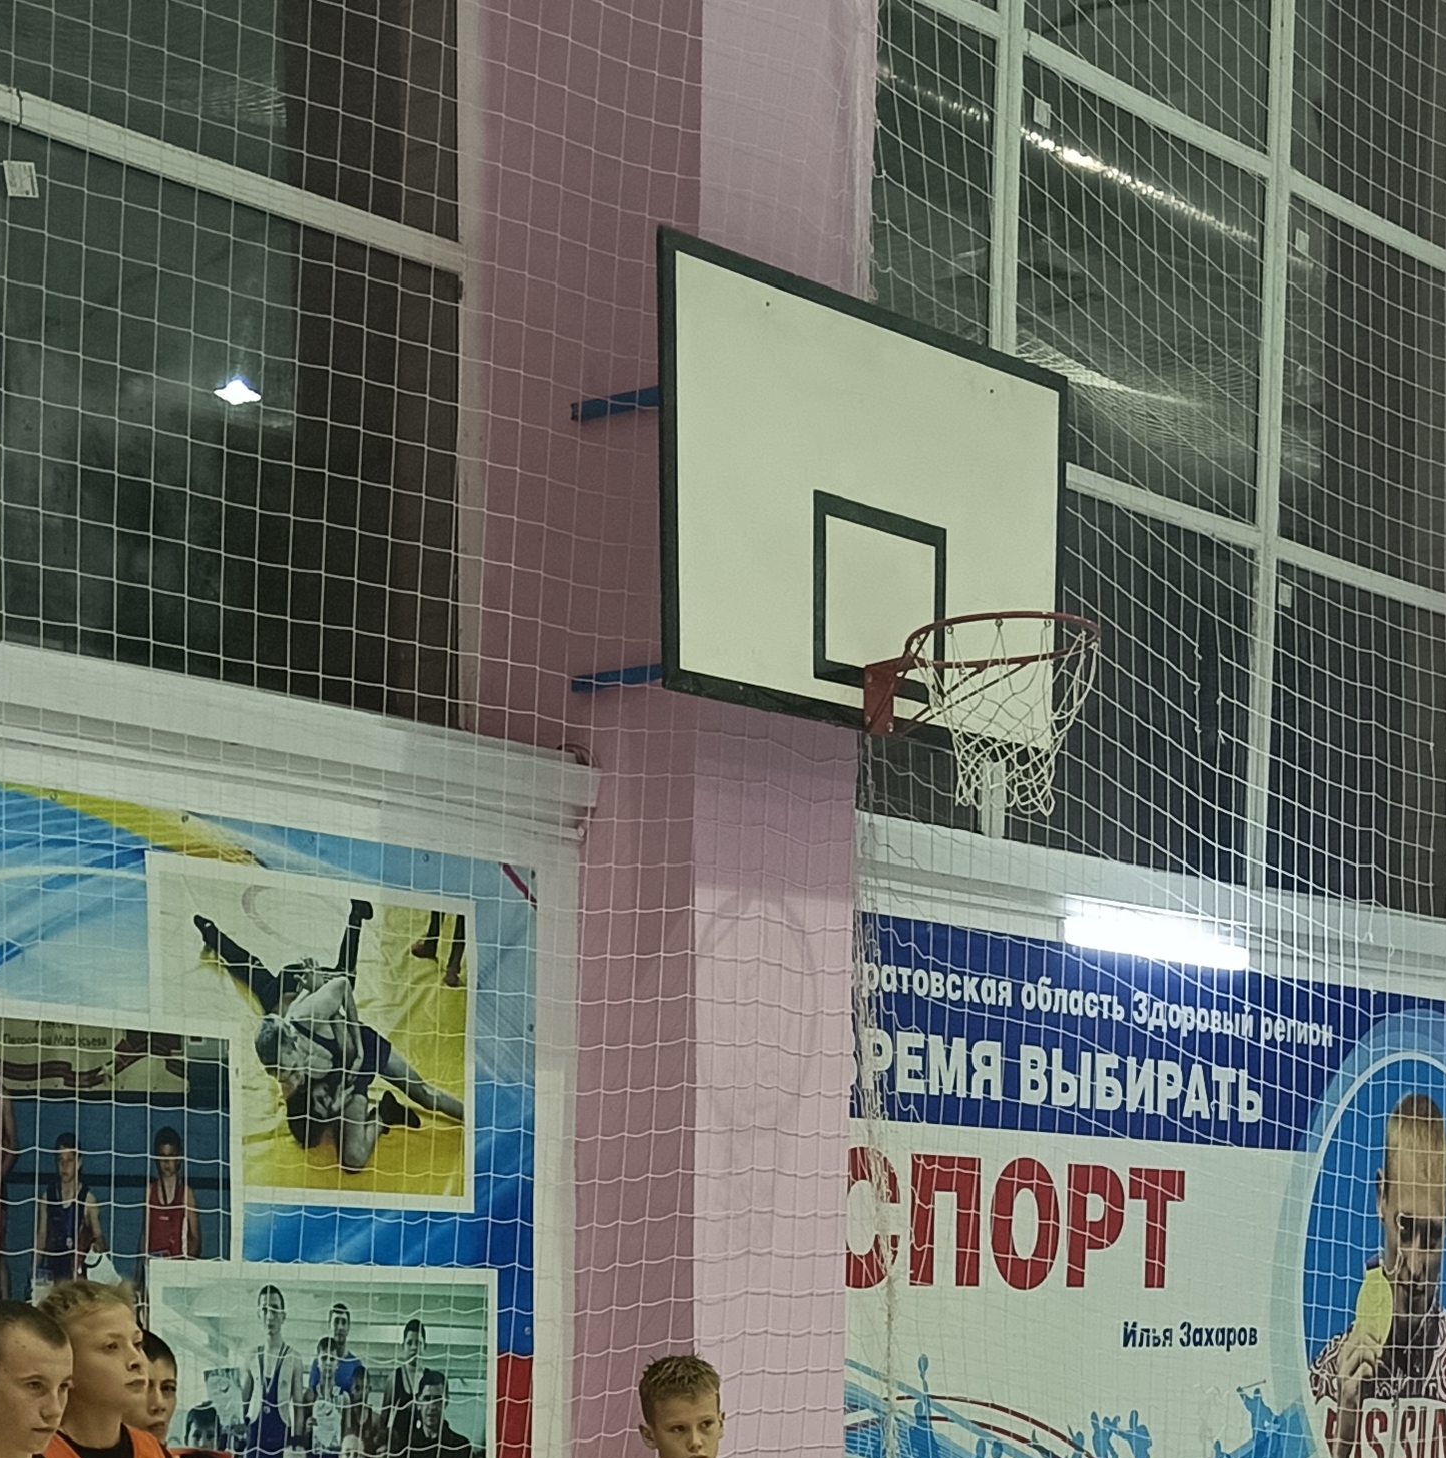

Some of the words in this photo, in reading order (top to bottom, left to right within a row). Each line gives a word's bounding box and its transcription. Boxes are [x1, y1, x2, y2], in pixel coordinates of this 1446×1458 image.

[1021, 978, 1125, 1021] область
[1133, 991, 1254, 1039] Здоровый
[1261, 1016, 1334, 1048] регион
[1020, 1045, 1263, 1123] ВЫБИРАТЬ
[845, 1146, 1186, 1290] СПОРТ
[1122, 1321, 1173, 1349] Илья
[1178, 1322, 1259, 1351] Захаров
